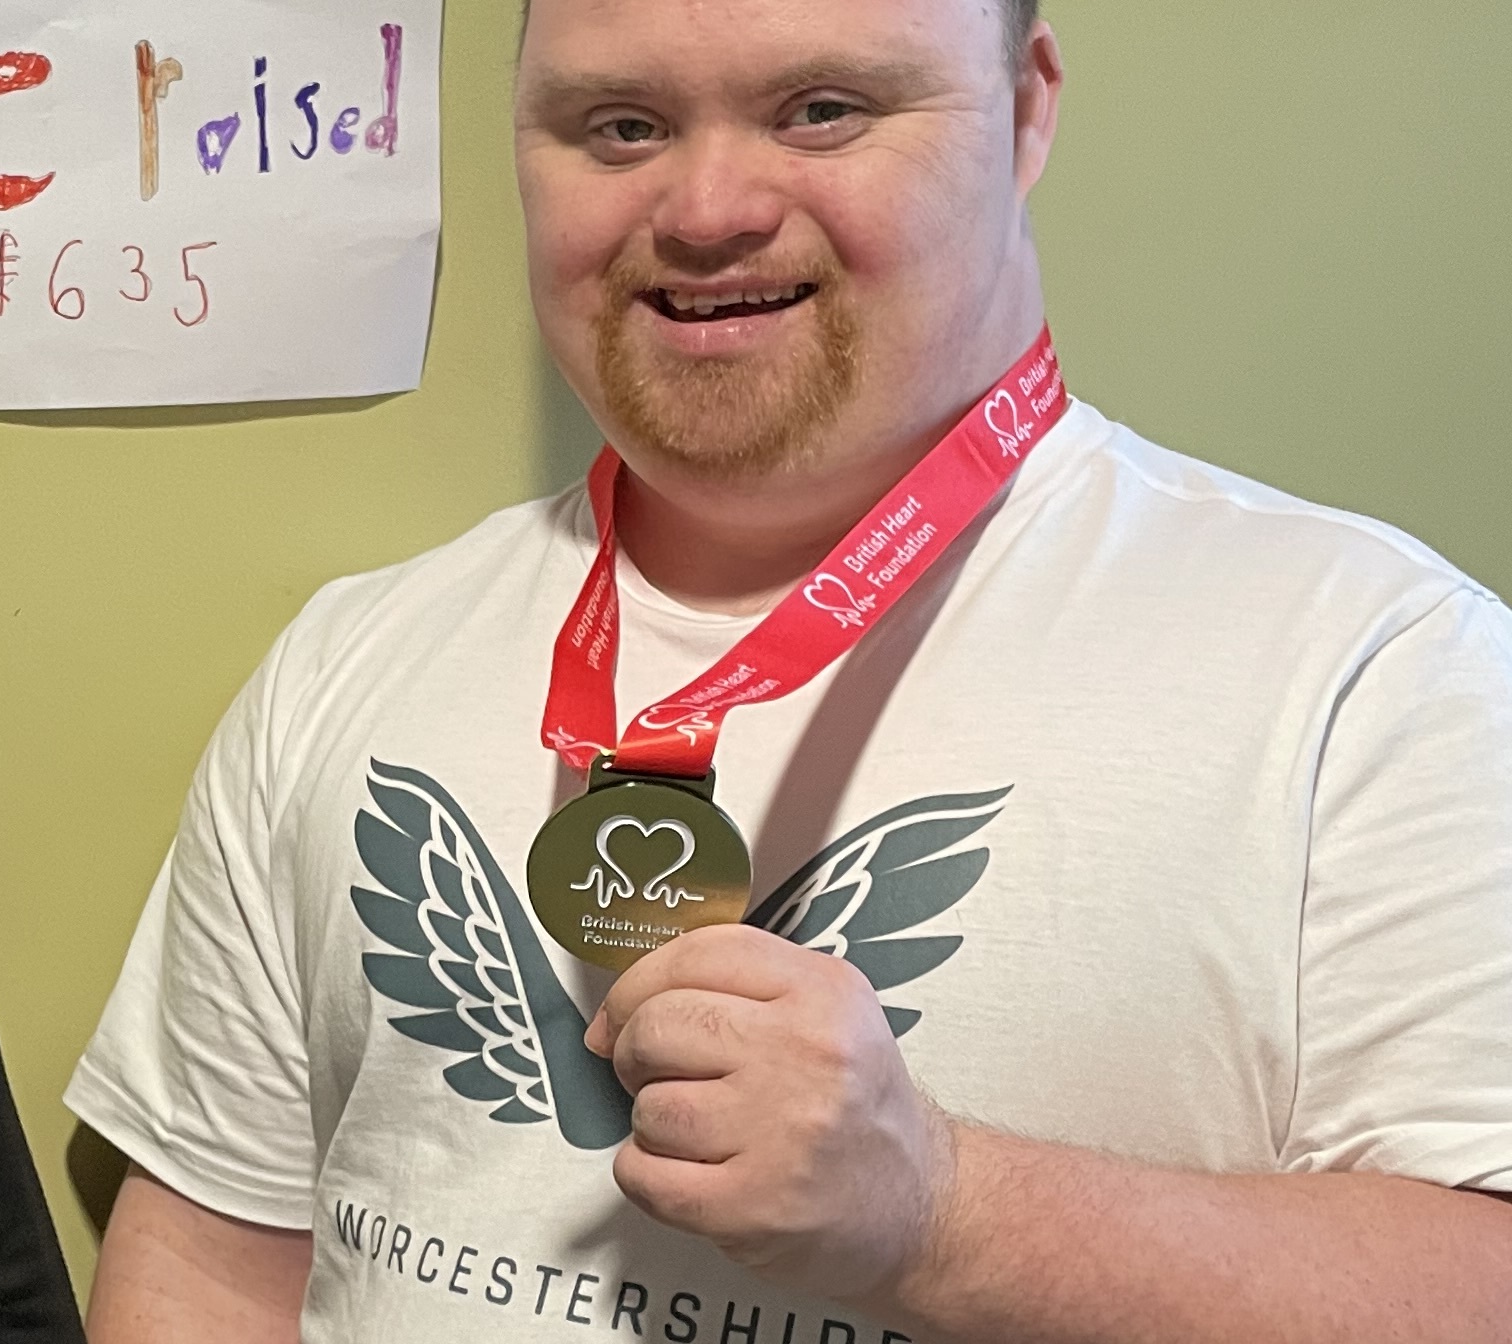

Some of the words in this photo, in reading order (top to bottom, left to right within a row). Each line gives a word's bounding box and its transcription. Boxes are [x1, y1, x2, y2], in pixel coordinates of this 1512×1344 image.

[135, 22, 404, 203] raised
[842, 528, 891, 575] British
[880, 493, 922, 536] Heart
[866, 522, 938, 590] Foundation
[581, 914, 634, 933] British
[583, 930, 665, 950] Foundati
